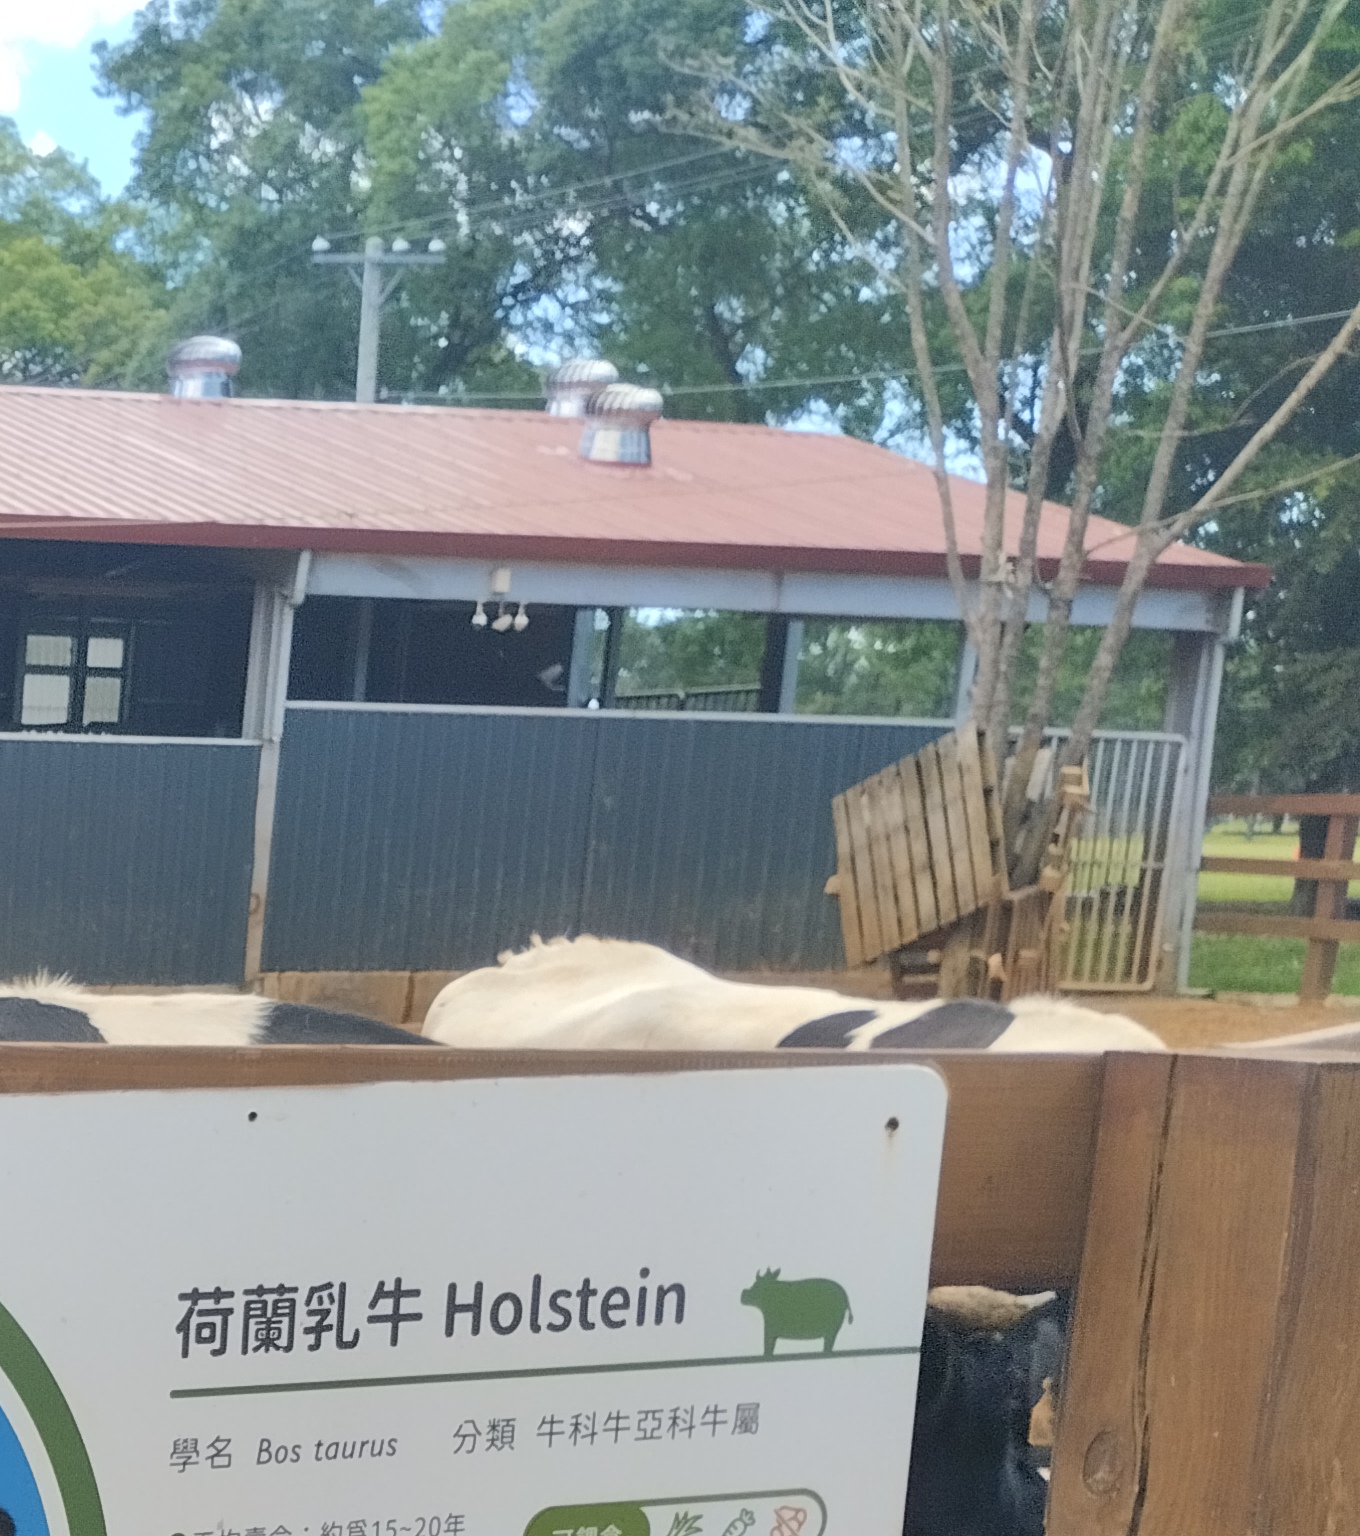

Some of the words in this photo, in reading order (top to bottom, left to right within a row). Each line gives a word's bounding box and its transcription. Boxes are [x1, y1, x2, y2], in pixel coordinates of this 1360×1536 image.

[175, 1276, 423, 1358] 荷蘭乳牛
[443, 1266, 687, 1338] Holstein
[168, 1435, 233, 1474] 學名
[255, 1437, 302, 1466] Bos
[313, 1436, 399, 1463] taurus
[452, 1417, 517, 1455] 分類
[535, 1402, 761, 1449] 牛科牛亞科牛屬
